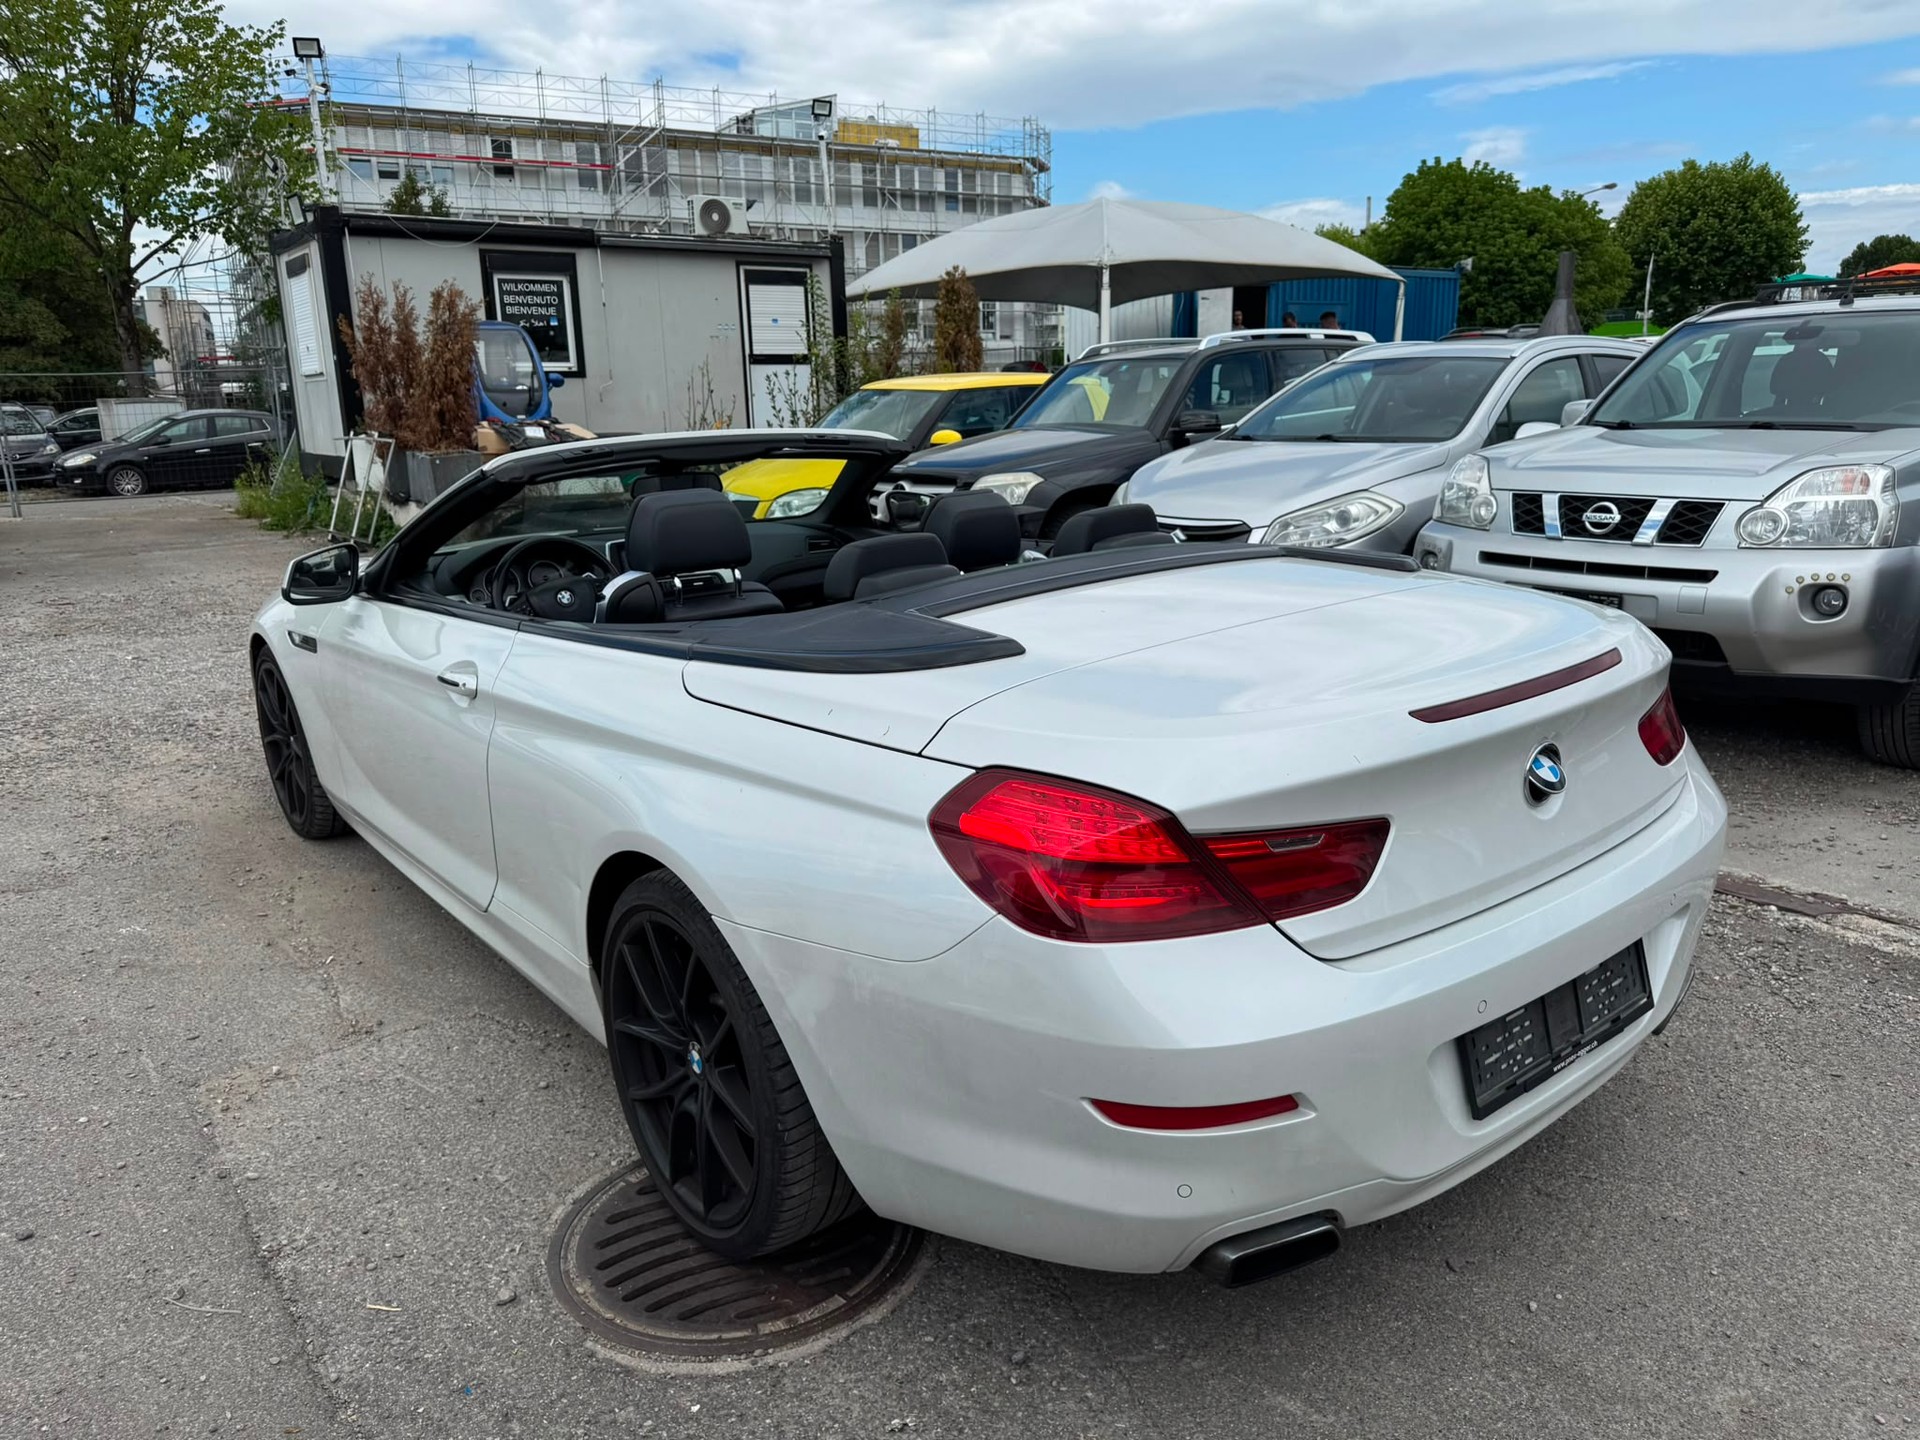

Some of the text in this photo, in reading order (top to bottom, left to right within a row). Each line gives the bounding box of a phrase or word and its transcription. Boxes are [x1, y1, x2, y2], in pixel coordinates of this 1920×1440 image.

[501, 282, 557, 292] WILKOMMEN
[503, 295, 558, 304] BENVENUTO
[505, 305, 557, 315] BIENVENUE
